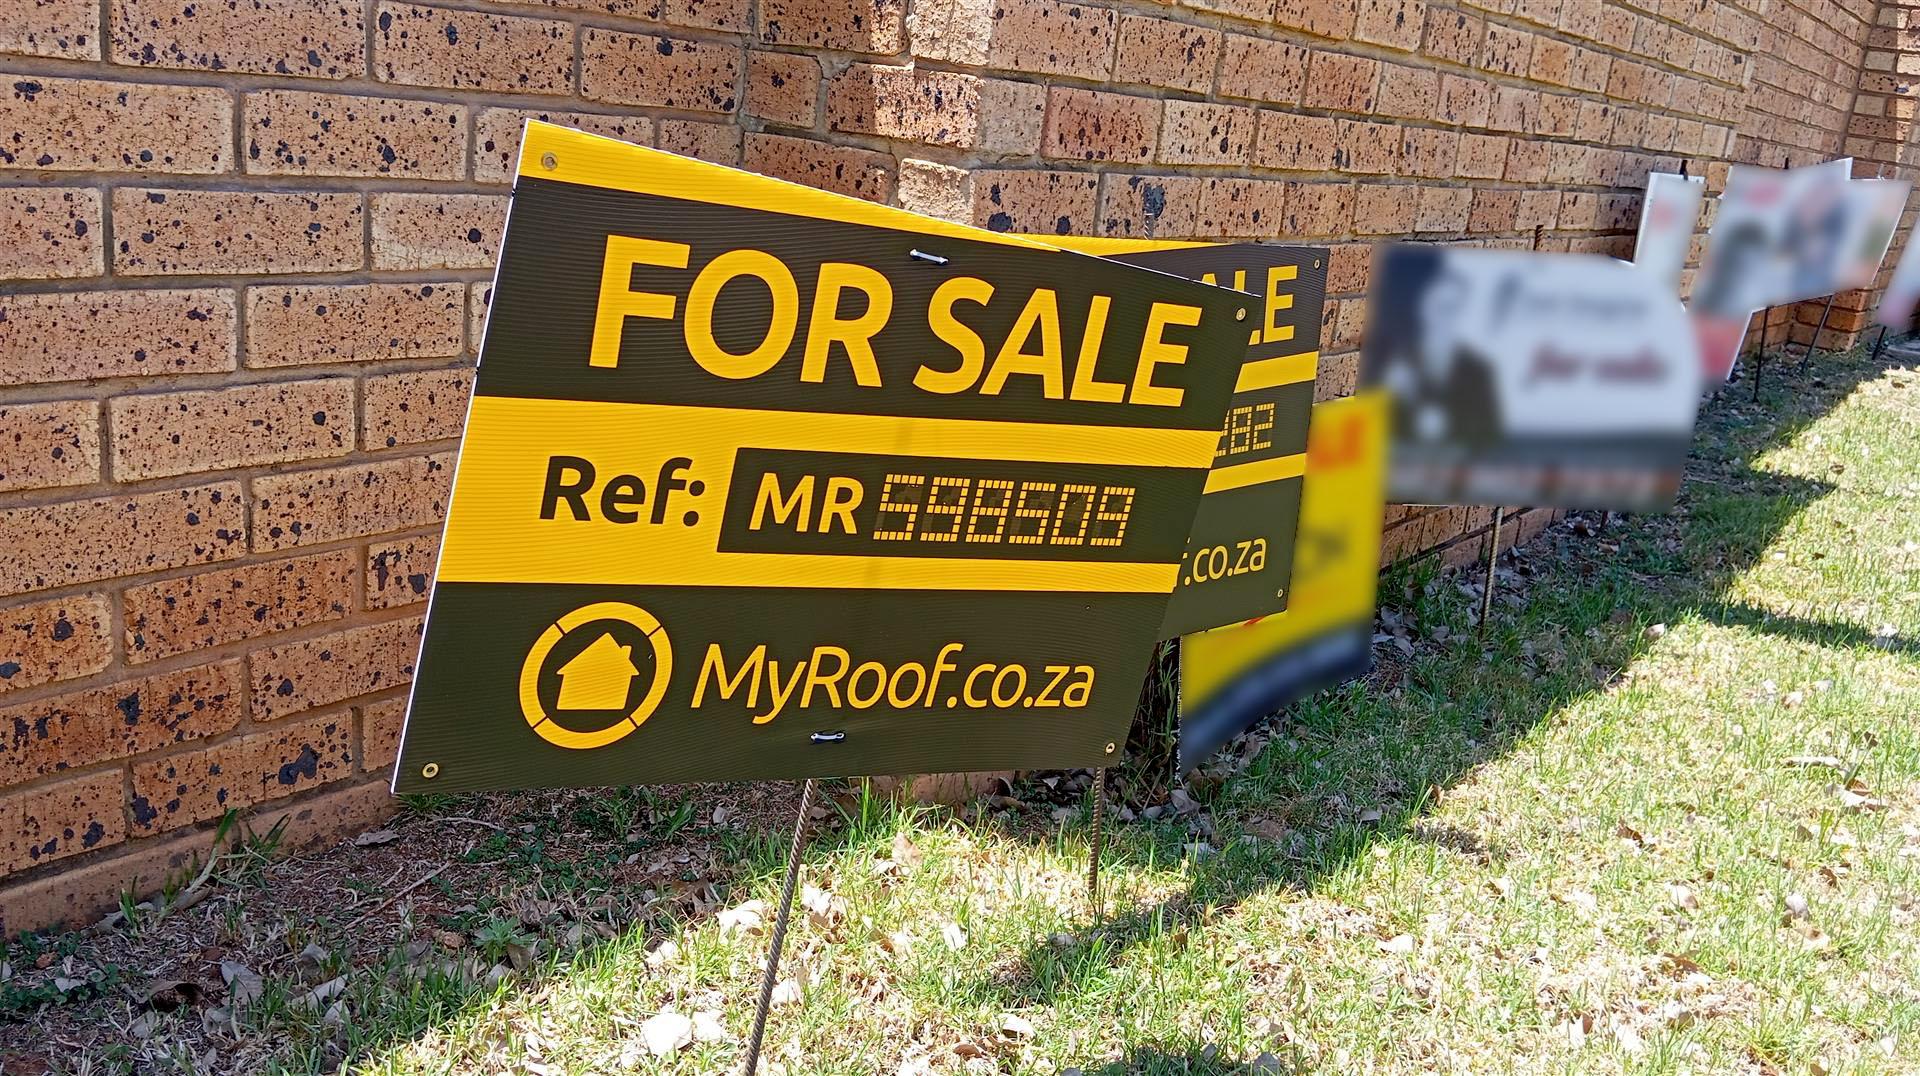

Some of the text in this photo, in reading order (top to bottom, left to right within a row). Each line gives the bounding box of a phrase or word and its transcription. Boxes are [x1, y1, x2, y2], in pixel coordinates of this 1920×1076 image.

[589, 234, 893, 388] FOR
[913, 276, 1203, 407] SALE
[540, 456, 1136, 547] Ref: MR 598509
[1183, 537, 1267, 586] .co.za
[691, 643, 1095, 725] MyRoof.co.za
